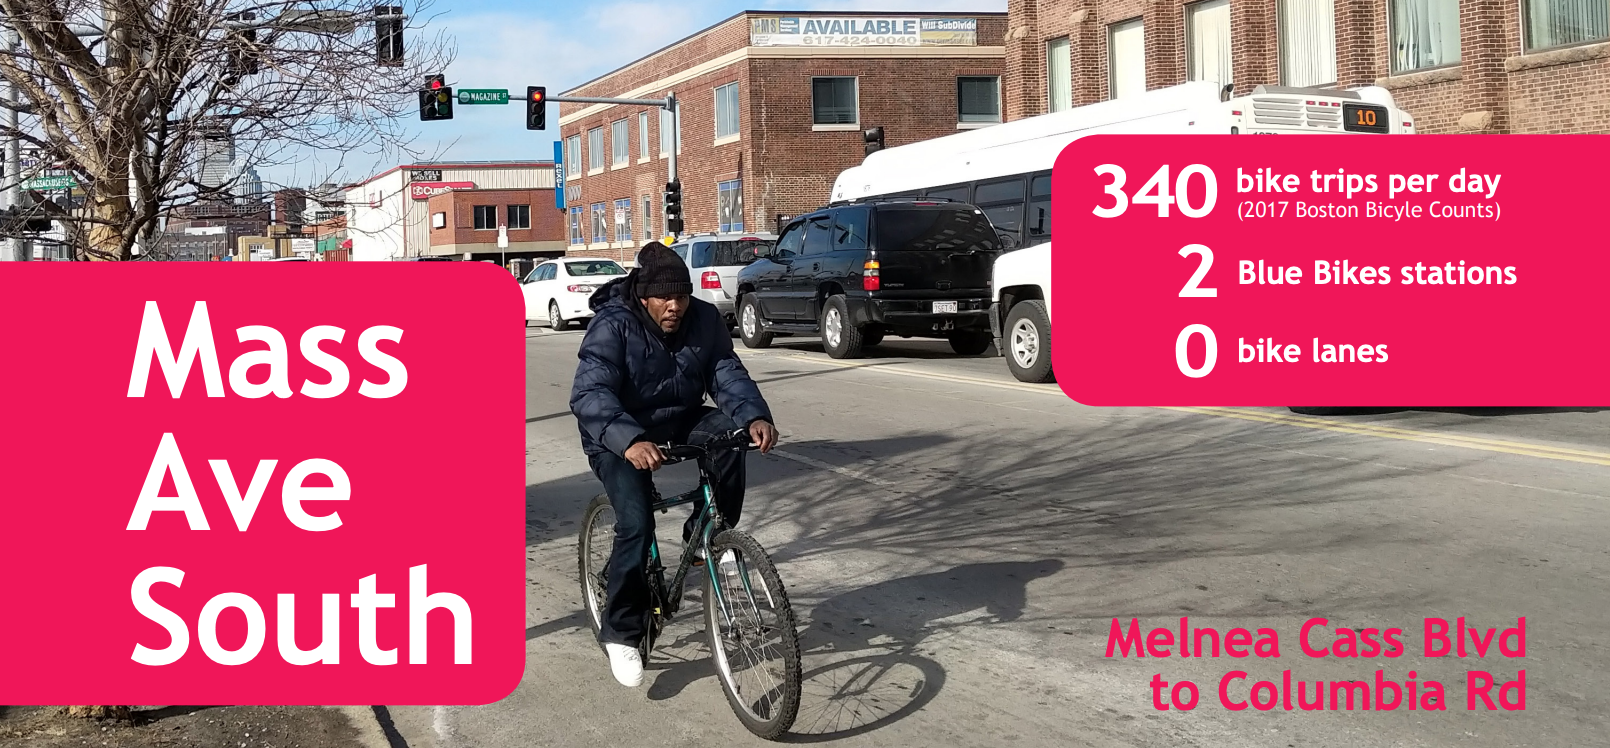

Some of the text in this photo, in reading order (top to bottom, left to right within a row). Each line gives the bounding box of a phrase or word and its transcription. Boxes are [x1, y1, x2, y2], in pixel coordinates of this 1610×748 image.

[754, 19, 777, 34] PMS
[803, 19, 916, 34] AVAILABLE
[921, 20, 976, 30] Will SubDivide
[802, 36, 917, 45] 617-424-0040
[470, 92, 501, 101] MAGAZINE
[1356, 109, 1377, 126] 10
